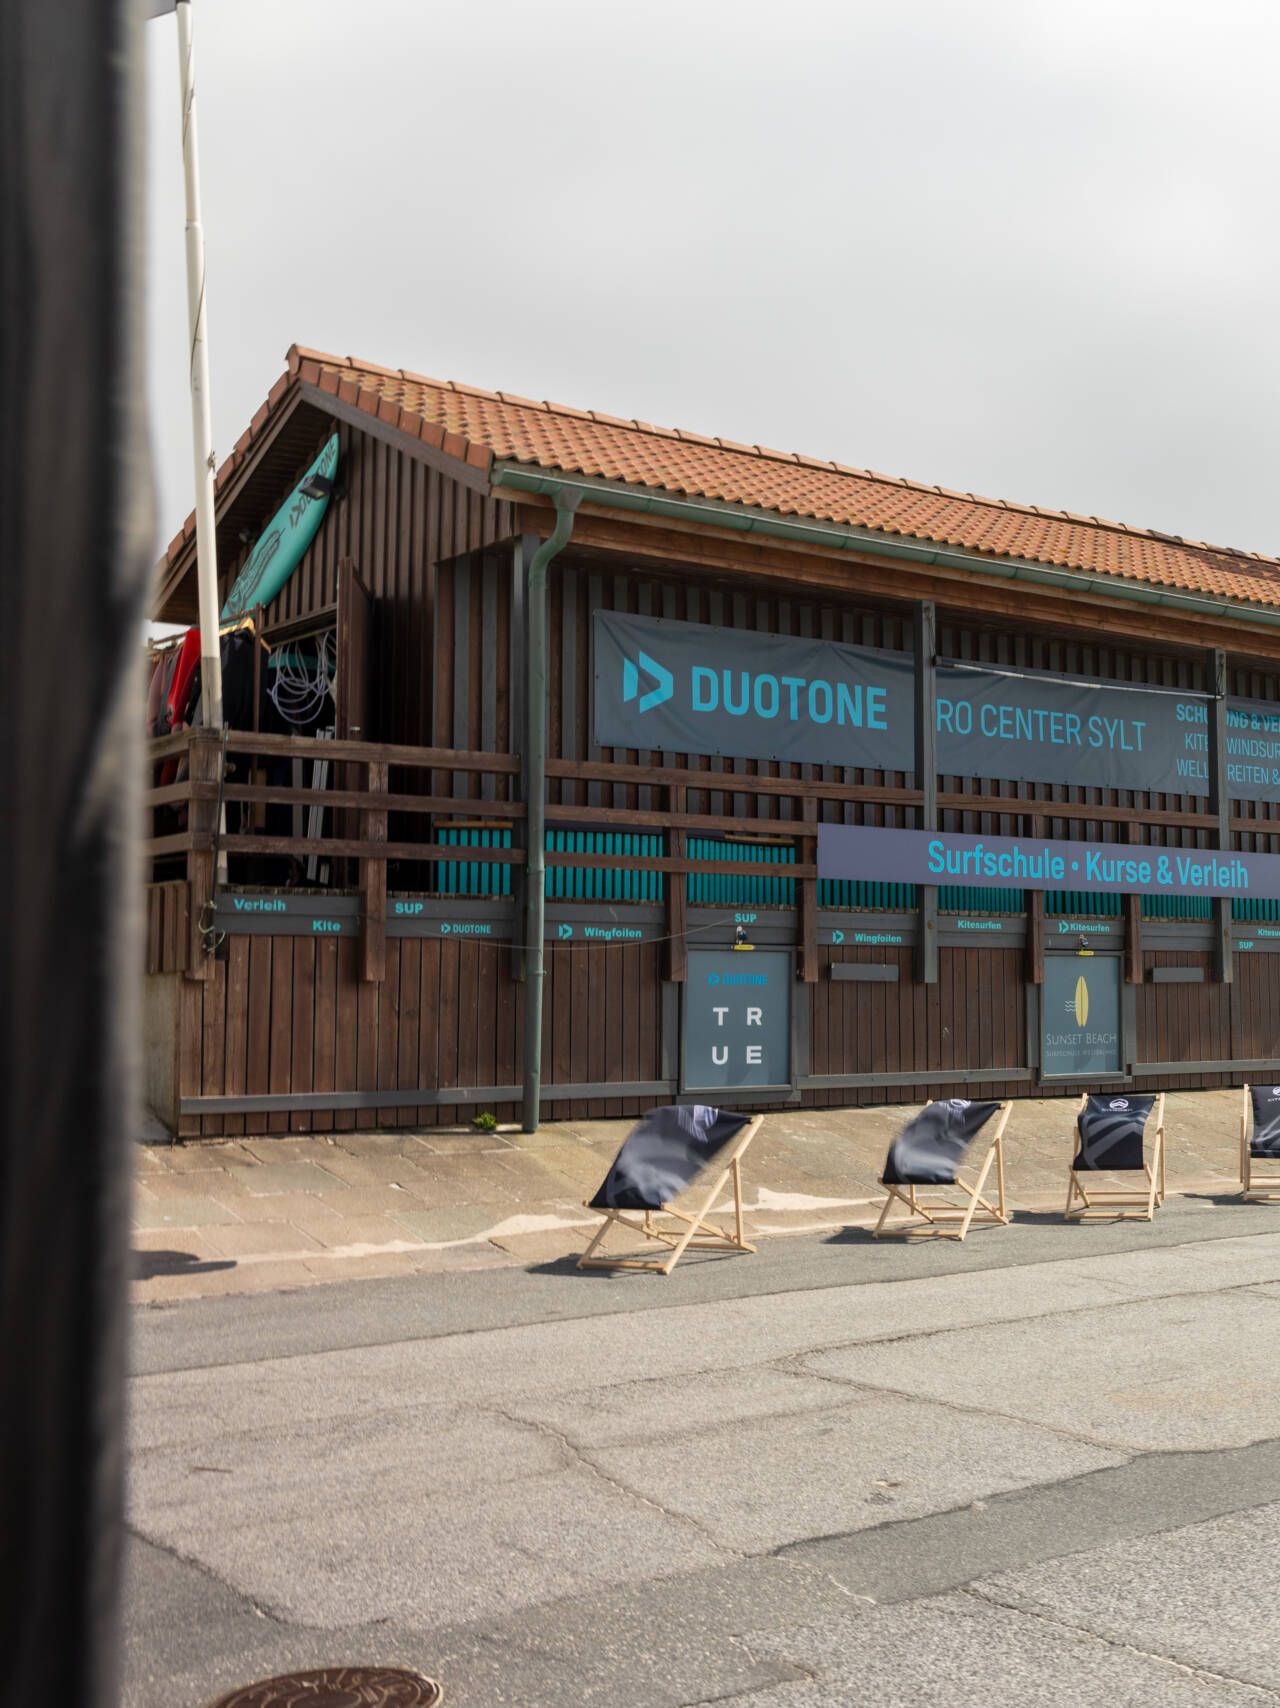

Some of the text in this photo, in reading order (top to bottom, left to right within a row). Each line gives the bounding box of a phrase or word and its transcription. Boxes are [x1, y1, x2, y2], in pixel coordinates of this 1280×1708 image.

[692, 666, 888, 730] DUOTONE
[936, 698, 1147, 751] RO CENTER SYLT
[1251, 713, 1260, 730] &
[1272, 769, 1280, 785] &
[928, 840, 1065, 880] Surfschule
[1086, 851, 1151, 884] Kurse
[1156, 856, 1174, 885] &
[1176, 857, 1249, 889] Verleih
[233, 899, 286, 912] Verleih
[395, 903, 423, 914] SUP
[735, 913, 757, 923] SUP
[312, 920, 341, 932] Kite
[452, 924, 492, 934] DUOTONE
[957, 920, 1002, 930] Kitesurfen
[1069, 923, 1110, 933] Kitesurfen
[584, 927, 642, 940] Wingfoilen
[854, 934, 902, 945] Wingfoilen
[1046, 1033, 1117, 1045] SUNSET BEACH
